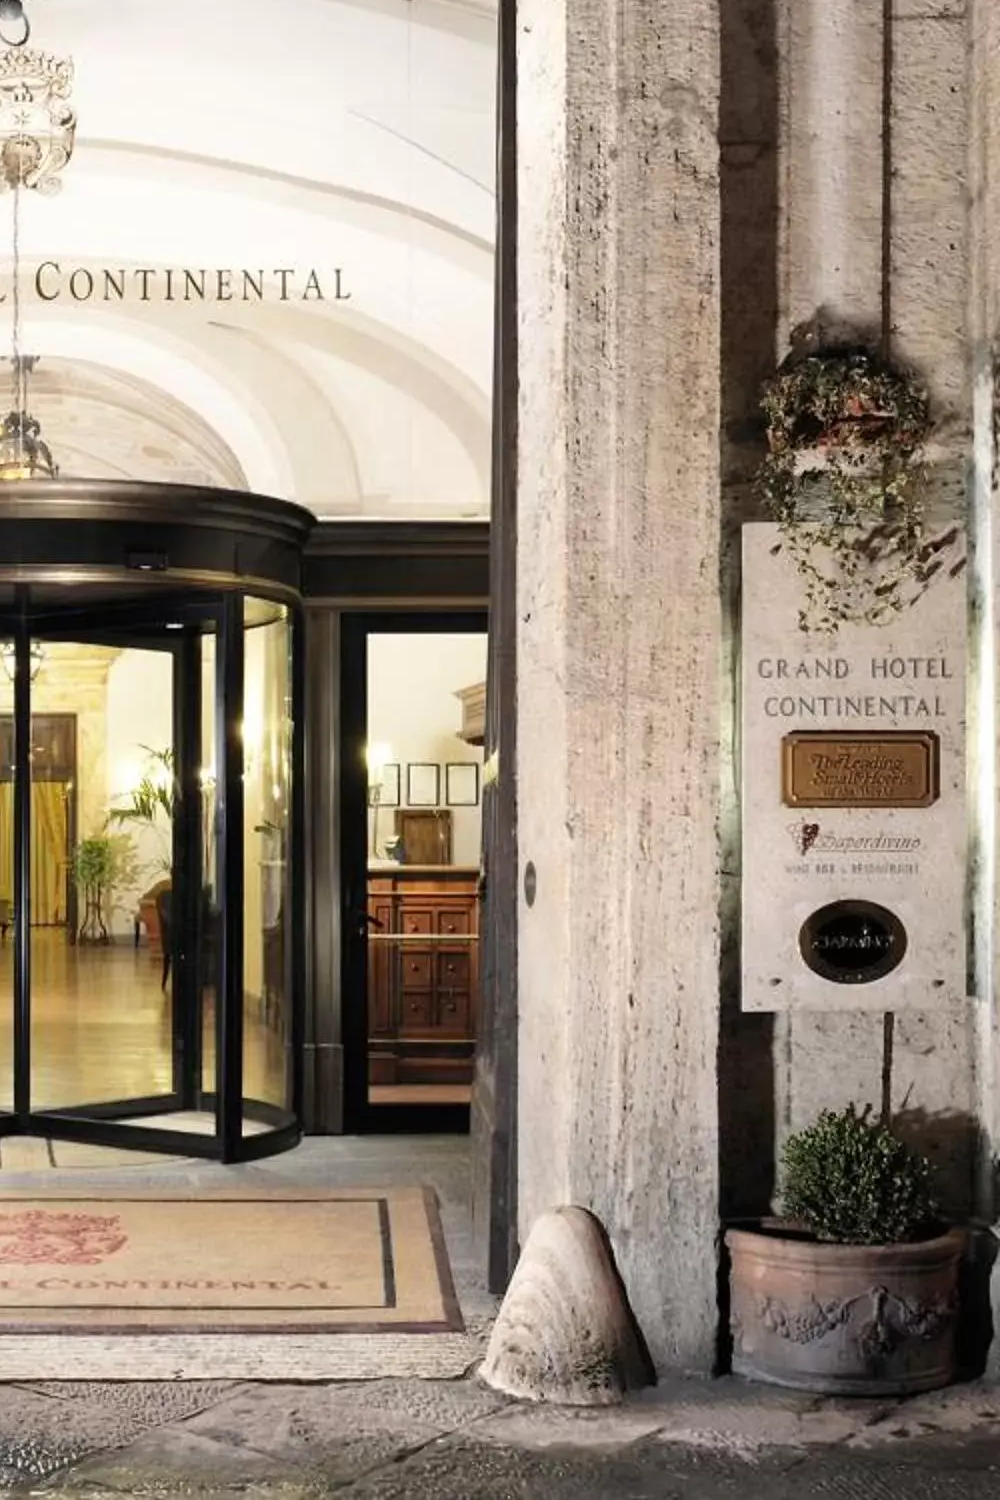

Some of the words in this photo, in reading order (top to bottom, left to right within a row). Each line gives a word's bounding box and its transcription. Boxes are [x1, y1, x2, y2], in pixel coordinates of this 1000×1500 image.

[34, 260, 352, 303] CONTINENTAL
[757, 658, 849, 679] GRAND
[871, 657, 953, 679] HOTEL
[764, 696, 946, 717] CONTINENTAL
[36, 1278, 343, 1291] CONTINENTAL
